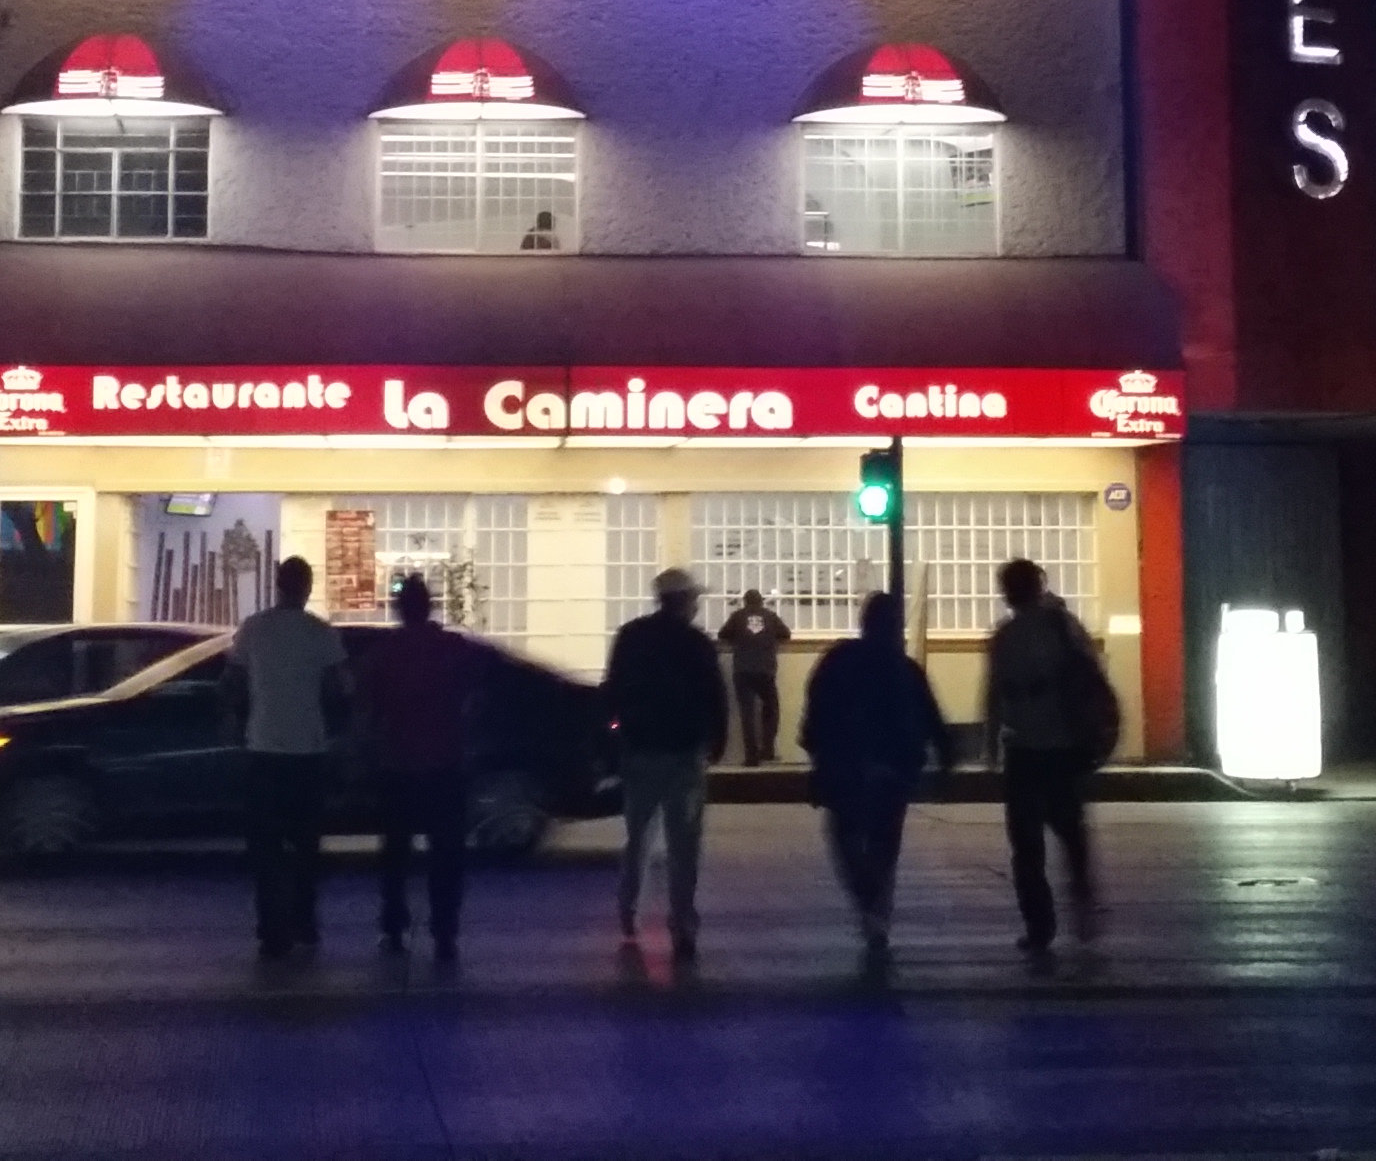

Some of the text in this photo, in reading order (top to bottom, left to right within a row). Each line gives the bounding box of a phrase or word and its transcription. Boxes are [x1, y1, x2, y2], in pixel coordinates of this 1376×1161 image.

[92, 375, 1008, 430] Restaurante La Caminera Cantina
[1089, 389, 1180, 420] Corona
[1116, 413, 1165, 433] Extra
